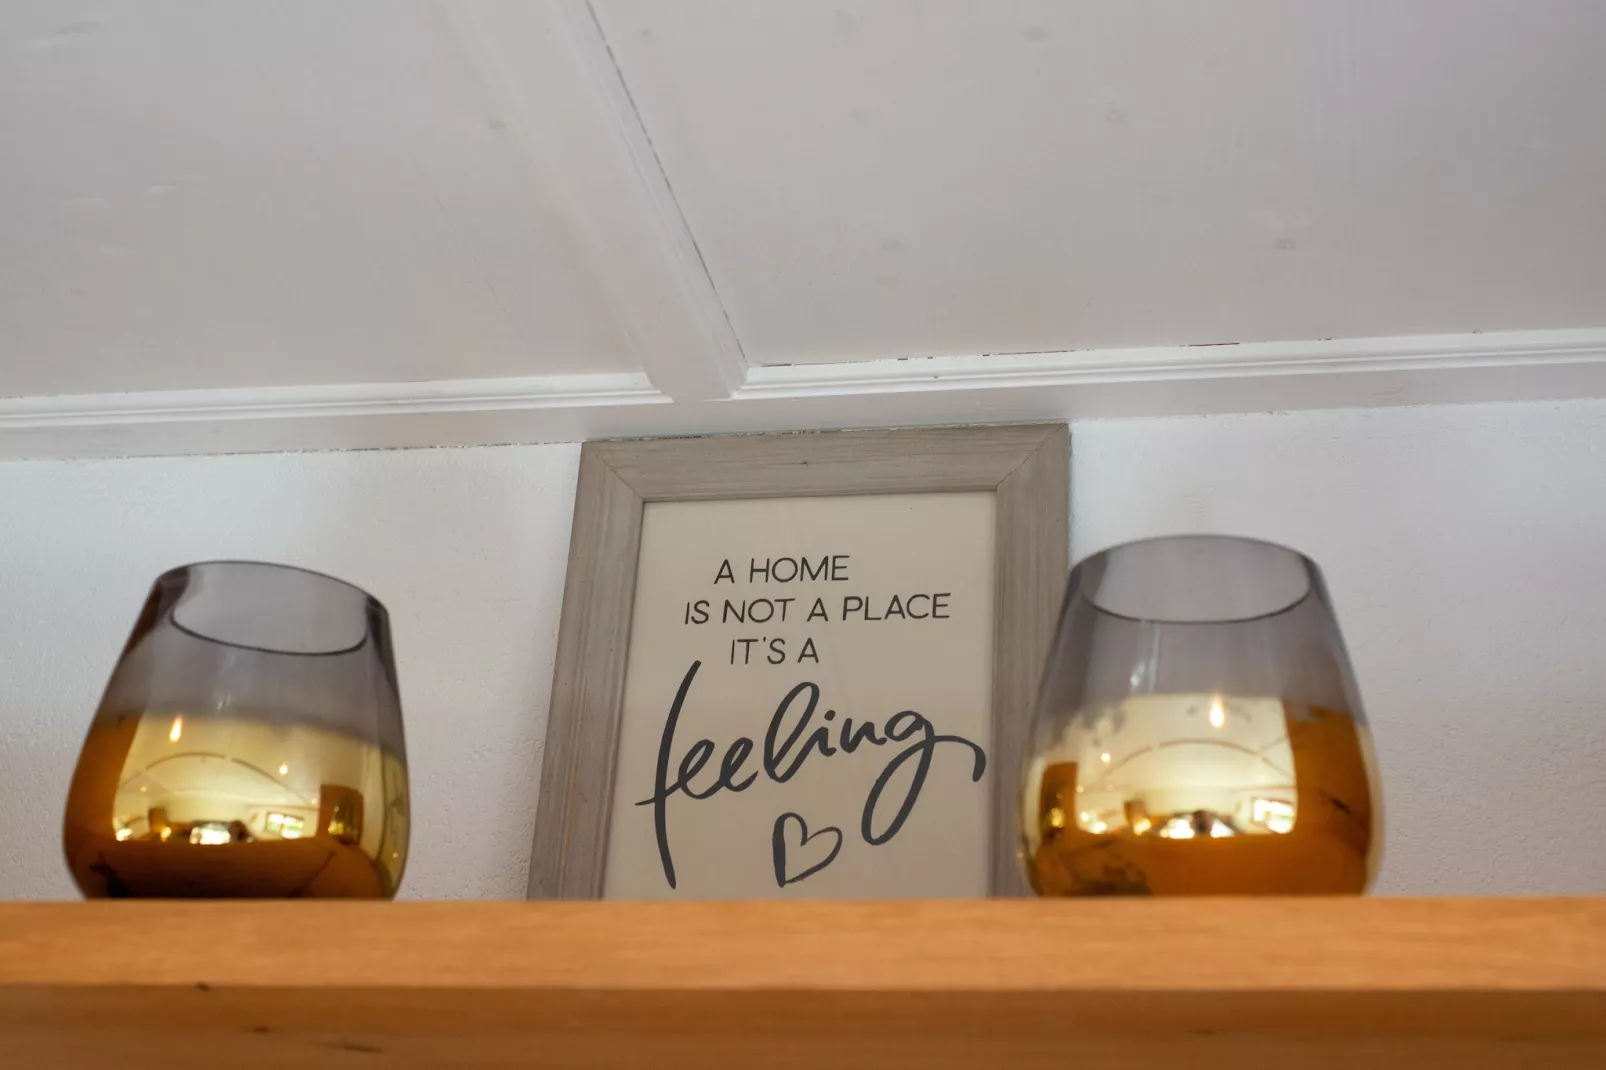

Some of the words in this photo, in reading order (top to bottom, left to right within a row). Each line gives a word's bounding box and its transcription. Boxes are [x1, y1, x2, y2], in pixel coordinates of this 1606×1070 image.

[714, 558, 735, 585] A
[750, 555, 850, 583] HOME
[685, 600, 710, 625] IS
[722, 598, 796, 624] NOT
[807, 597, 829, 622] A
[842, 593, 951, 621] PLACE
[730, 636, 786, 665] IT'S
[797, 637, 819, 664] A
[634, 660, 987, 889] feeling
